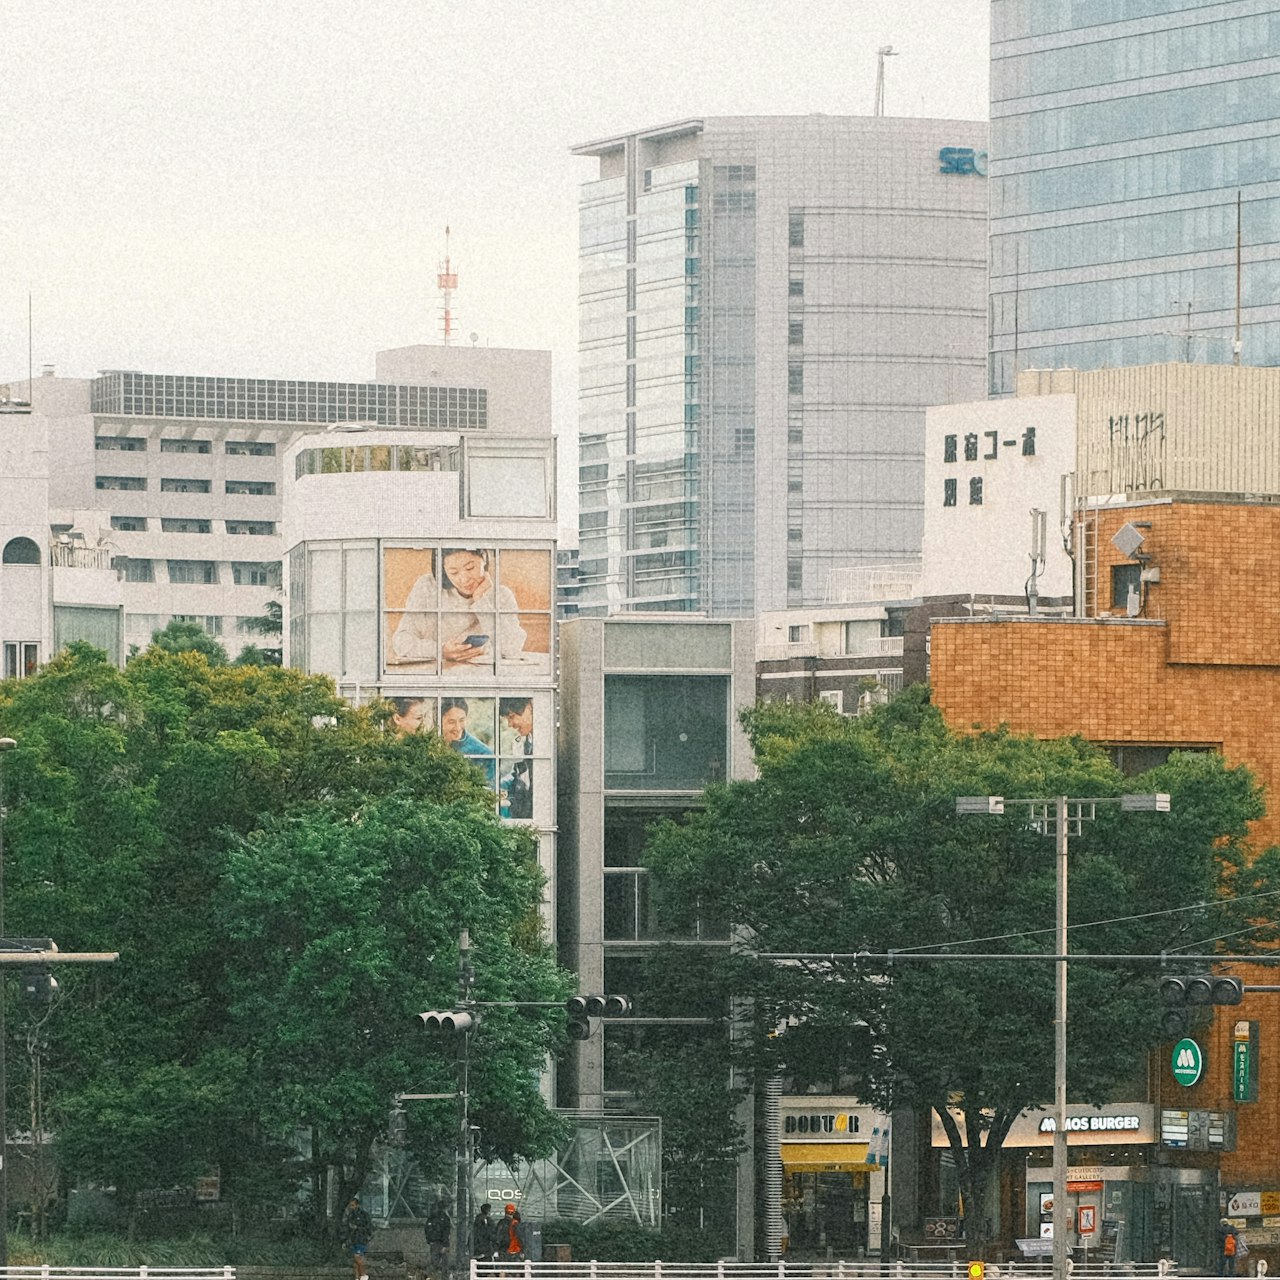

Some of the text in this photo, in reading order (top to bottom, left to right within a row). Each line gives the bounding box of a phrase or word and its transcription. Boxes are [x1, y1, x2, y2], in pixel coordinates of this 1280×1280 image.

[943, 427, 1036, 463] 原宿コーポ
[1090, 1116, 1139, 1130] BURGER
